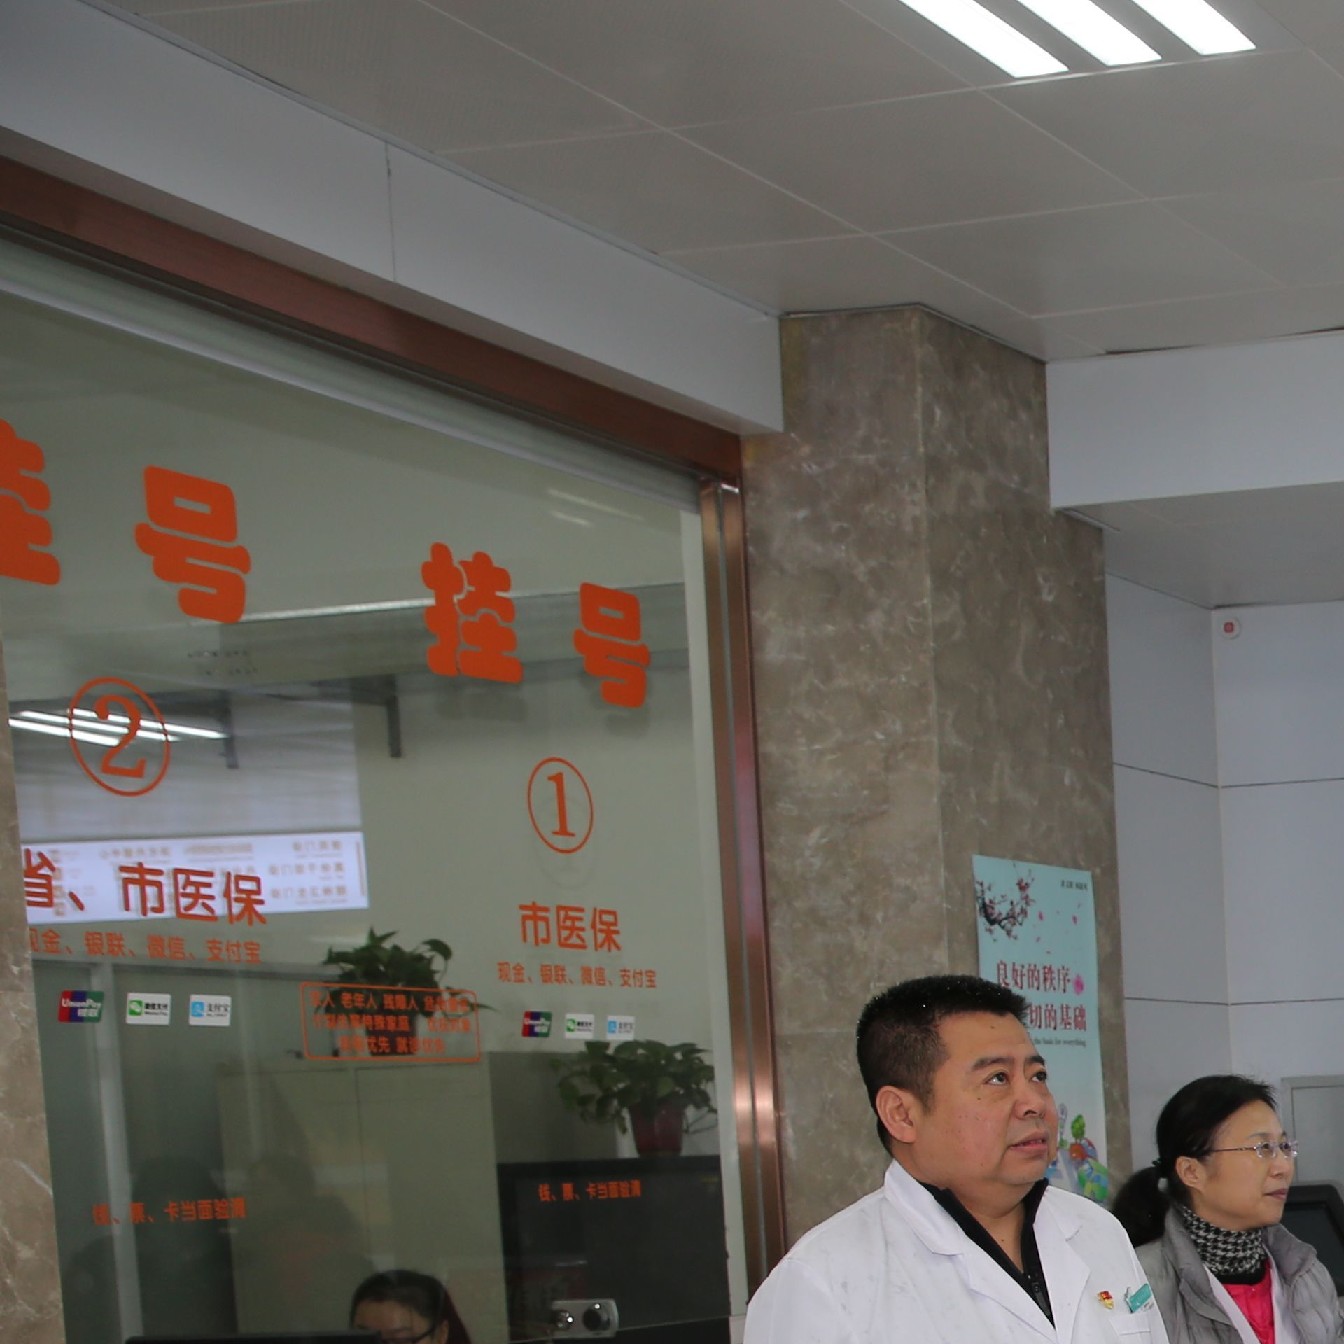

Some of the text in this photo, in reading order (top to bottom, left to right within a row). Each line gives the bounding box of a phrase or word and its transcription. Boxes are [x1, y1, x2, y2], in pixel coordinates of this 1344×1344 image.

[421, 541, 651, 708] 挂号
[518, 901, 623, 953] 市医保
[996, 959, 1072, 994] 良好的秩序
[1026, 1003, 1088, 1032] 切的基础
